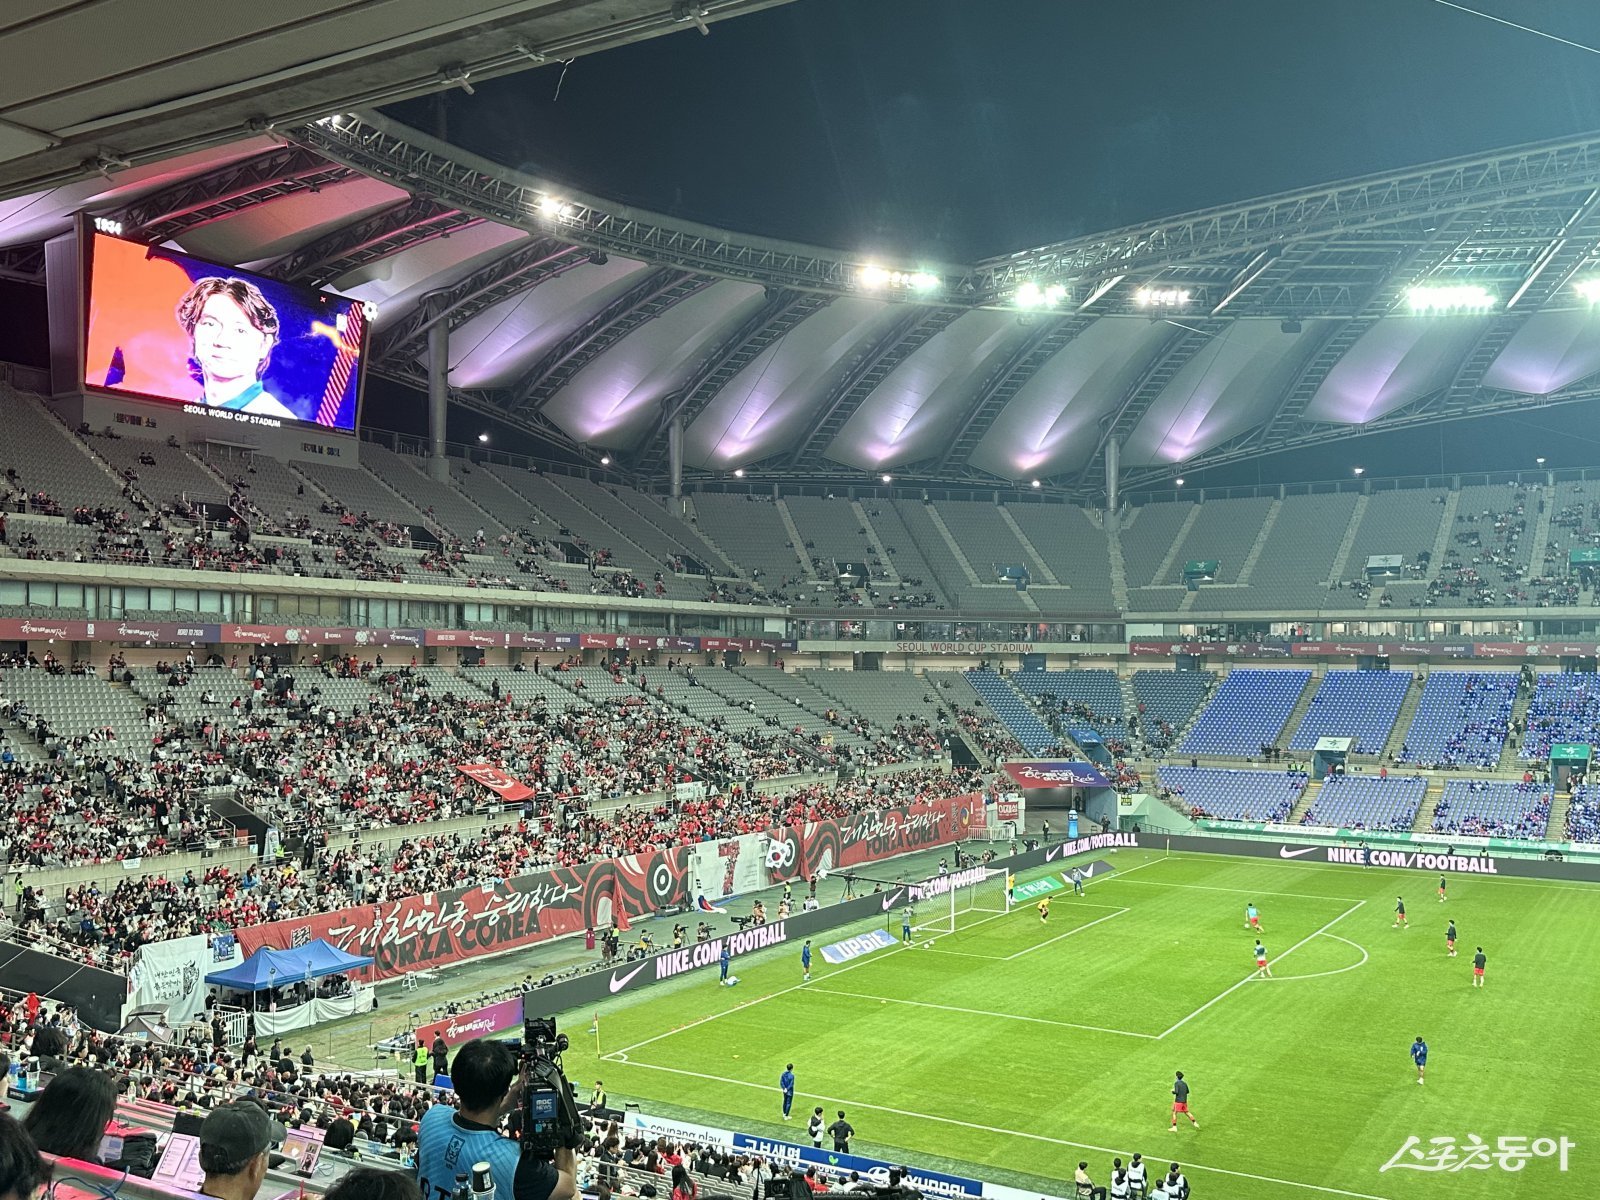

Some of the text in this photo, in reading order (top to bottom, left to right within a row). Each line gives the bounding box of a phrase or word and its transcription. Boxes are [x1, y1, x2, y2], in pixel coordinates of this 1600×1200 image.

[183, 404, 281, 428] SEOUL WORLD CUP STADIUM
[896, 642, 1034, 653] SEOUL WORLD CUP STADIUM
[840, 814, 898, 843] 대한민국
[898, 810, 946, 832] 승리한다
[1327, 847, 1497, 873] NIKECOM/FOOTBALL
[329, 901, 470, 952] 대한민국
[473, 883, 583, 925] 승리한다
[458, 906, 541, 951] COREA
